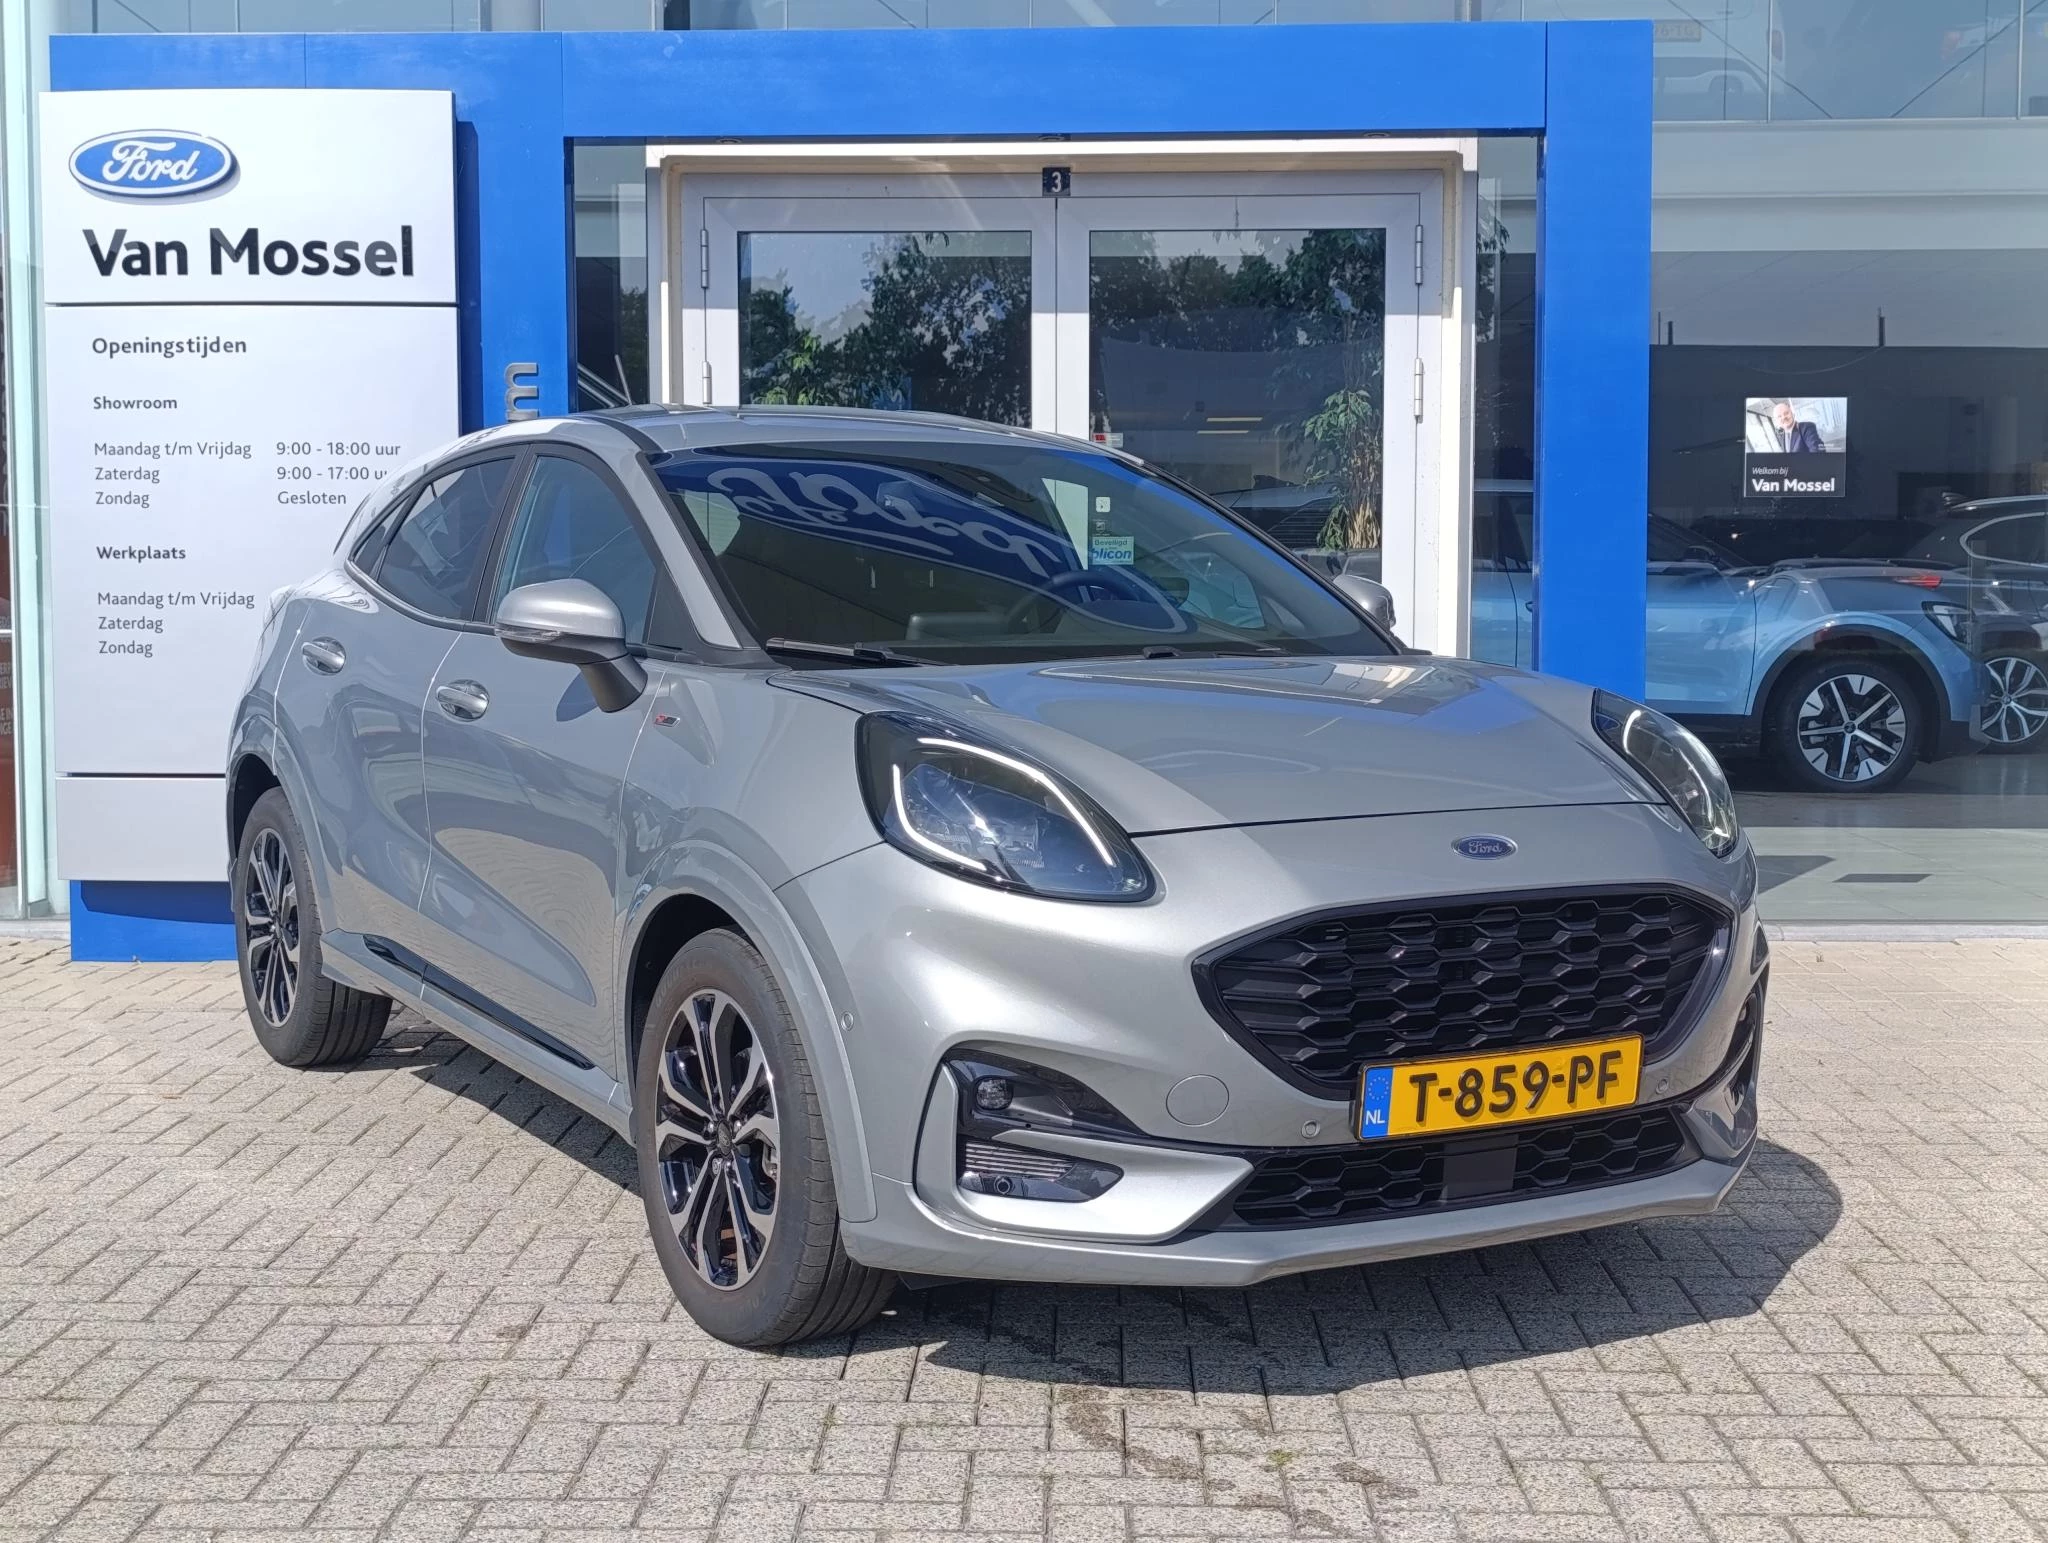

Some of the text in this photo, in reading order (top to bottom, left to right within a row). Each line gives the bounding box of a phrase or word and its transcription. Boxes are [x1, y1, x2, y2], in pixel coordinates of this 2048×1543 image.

[102, 140, 200, 182] Ford
[1052, 171, 1062, 193] 3
[82, 224, 414, 277] Van Mossel
[92, 335, 247, 359] Openingstijden
[93, 395, 178, 410] Showroom
[94, 441, 161, 460] Maandag
[164, 441, 193, 456] t/m
[196, 441, 252, 460] Vrijdag
[276, 441, 312, 456] 9:00
[327, 441, 371, 456] 18:00
[375, 445, 401, 456] uur
[94, 465, 161, 484] Zaterdag
[276, 466, 312, 480] 9:00
[327, 466, 370, 480] 17:00
[1752, 466, 1789, 477] Welkom bij
[1752, 477, 1836, 492] Van Mossel
[95, 490, 347, 509] Zondag Gesloten
[96, 545, 187, 564] Werkplaats
[97, 591, 255, 610] Maandag t/m Vrijdag
[97, 615, 164, 634] Zaterdag
[98, 639, 154, 658] Zondag
[1468, 841, 1503, 854] Ford
[1408, 1050, 1622, 1123] T-859-PF
[1365, 1109, 1386, 1126] NL
